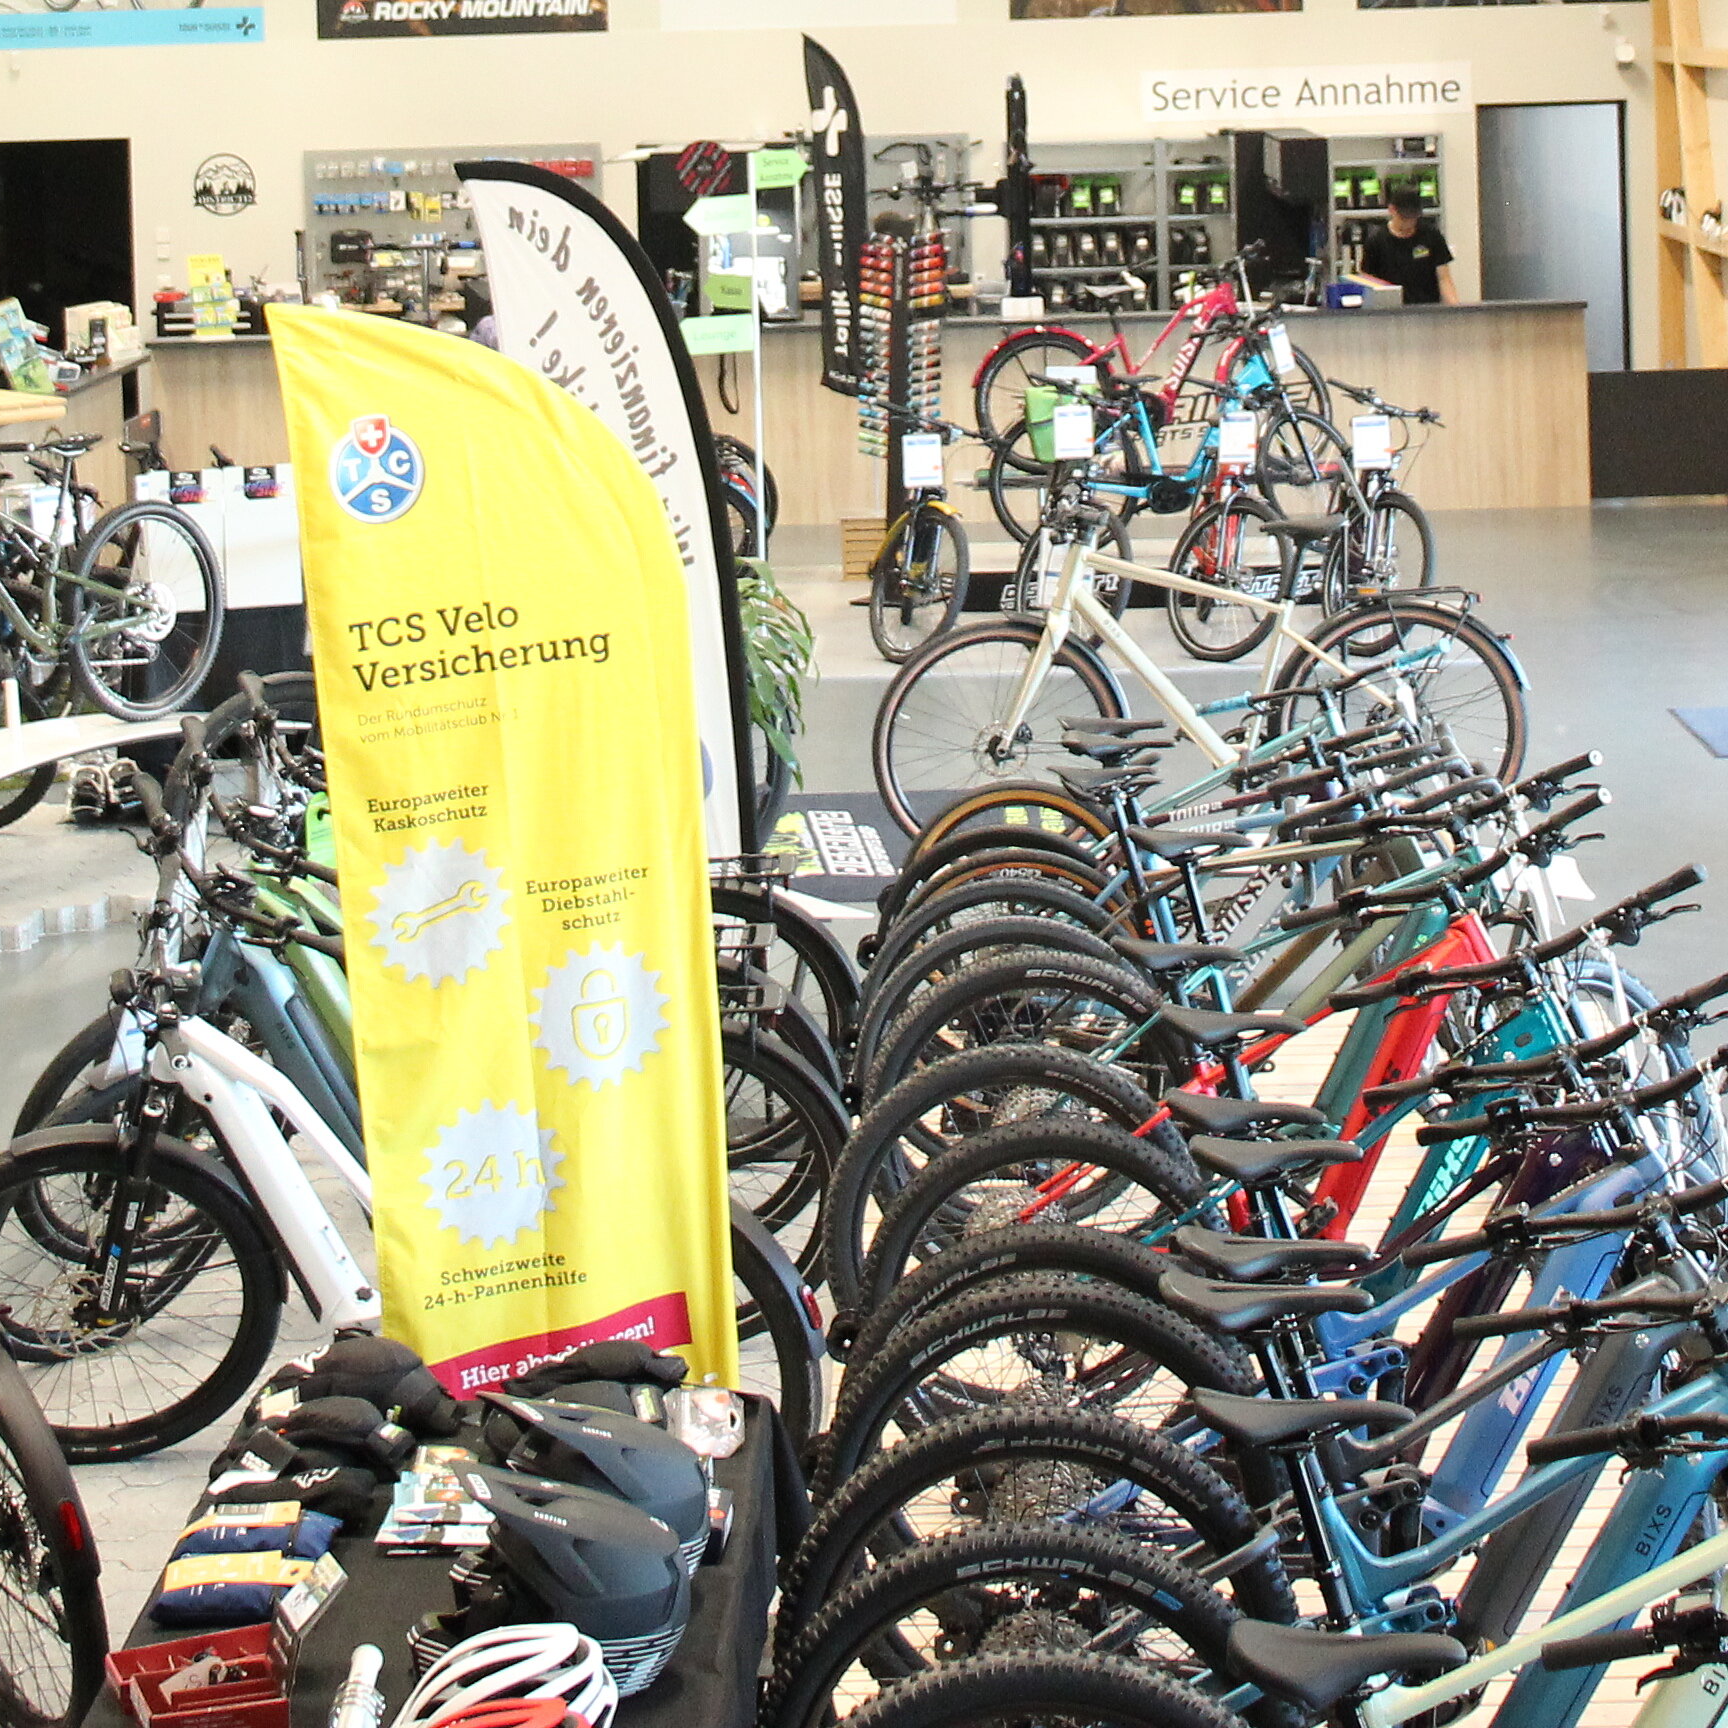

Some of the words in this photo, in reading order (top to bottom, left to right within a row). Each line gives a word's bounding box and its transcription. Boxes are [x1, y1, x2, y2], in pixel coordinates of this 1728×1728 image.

[373, 0, 459, 22] ROCKY
[1151, 79, 1281, 112] Service
[1294, 74, 1461, 107] Annahme
[1168, 316, 1209, 392] SUISE
[348, 613, 426, 652] TCS
[437, 602, 519, 636] Velo
[352, 632, 610, 692] Versicherung
[357, 713, 382, 727] Der
[386, 696, 488, 721] Rundumschutz
[360, 731, 390, 744] vom
[393, 714, 488, 739] Mobilitätsclub
[367, 783, 489, 813] Europaweiter
[1168, 803, 1209, 823] TOUR
[373, 804, 488, 833] Kaskoschutz
[525, 866, 649, 895] Europaweiter
[541, 887, 636, 913] Diebstahl-
[1212, 864, 1273, 948] SUISSE
[562, 911, 621, 931] schutz
[1025, 969, 1148, 1013] SCHWALBE
[443, 1154, 504, 1200] 24
[512, 1150, 546, 1190] h
[440, 1252, 566, 1286] Schweizweite
[424, 1270, 587, 1310] 24-h-Pannenhilfe
[910, 1308, 1069, 1369] SCHWALBE
[460, 1362, 512, 1390] Hier
[1635, 1503, 1672, 1557] BIXS
[956, 1556, 1156, 1597] SCHWALBE
